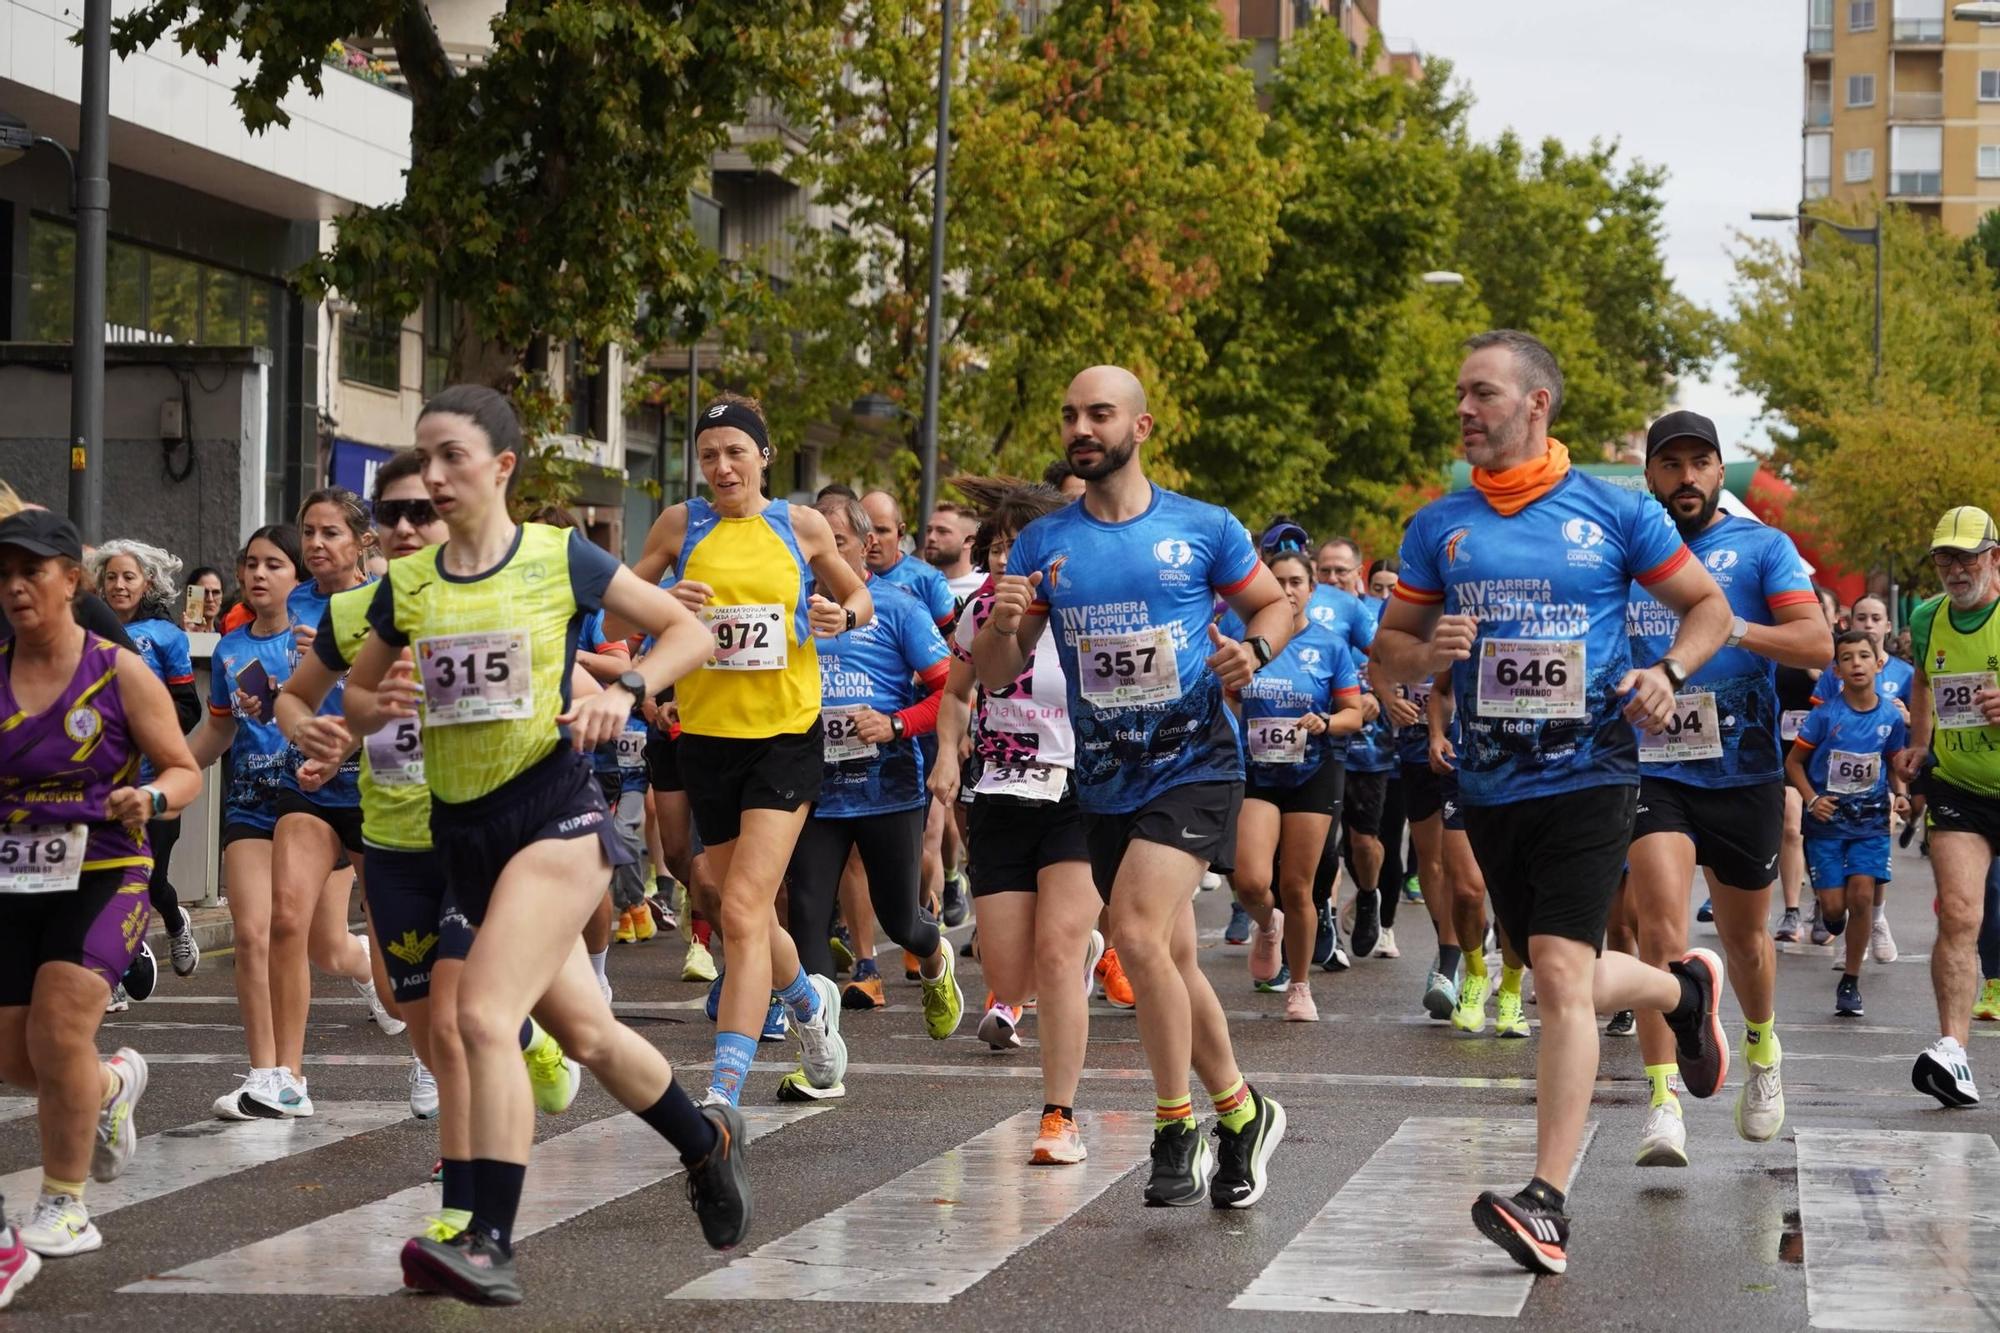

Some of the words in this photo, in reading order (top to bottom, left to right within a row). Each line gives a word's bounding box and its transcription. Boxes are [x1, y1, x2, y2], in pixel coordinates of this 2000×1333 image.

[1454, 582, 1486, 605] XIV
[1486, 579, 1552, 591] CARRERA
[1488, 591, 1552, 603] POPULAR
[1058, 605, 1089, 630] XIV
[1088, 600, 1149, 616] CARRERA
[1541, 603, 1589, 620] CIVIL
[1090, 612, 1149, 629] POPULAR
[1520, 620, 1590, 637] ZAMORA
[718, 622, 769, 650] 972
[435, 652, 510, 689] 315
[1094, 647, 1156, 678] 357
[834, 673, 874, 686] CIVIL
[1496, 658, 1567, 687] 646
[1510, 688, 1552, 697] FERNANDO
[1115, 729, 1149, 741] feder
[1503, 720, 1540, 733] feder
[1259, 728, 1297, 745] 164
[1839, 762, 1873, 779] 661
[0, 838, 67, 865] 519
